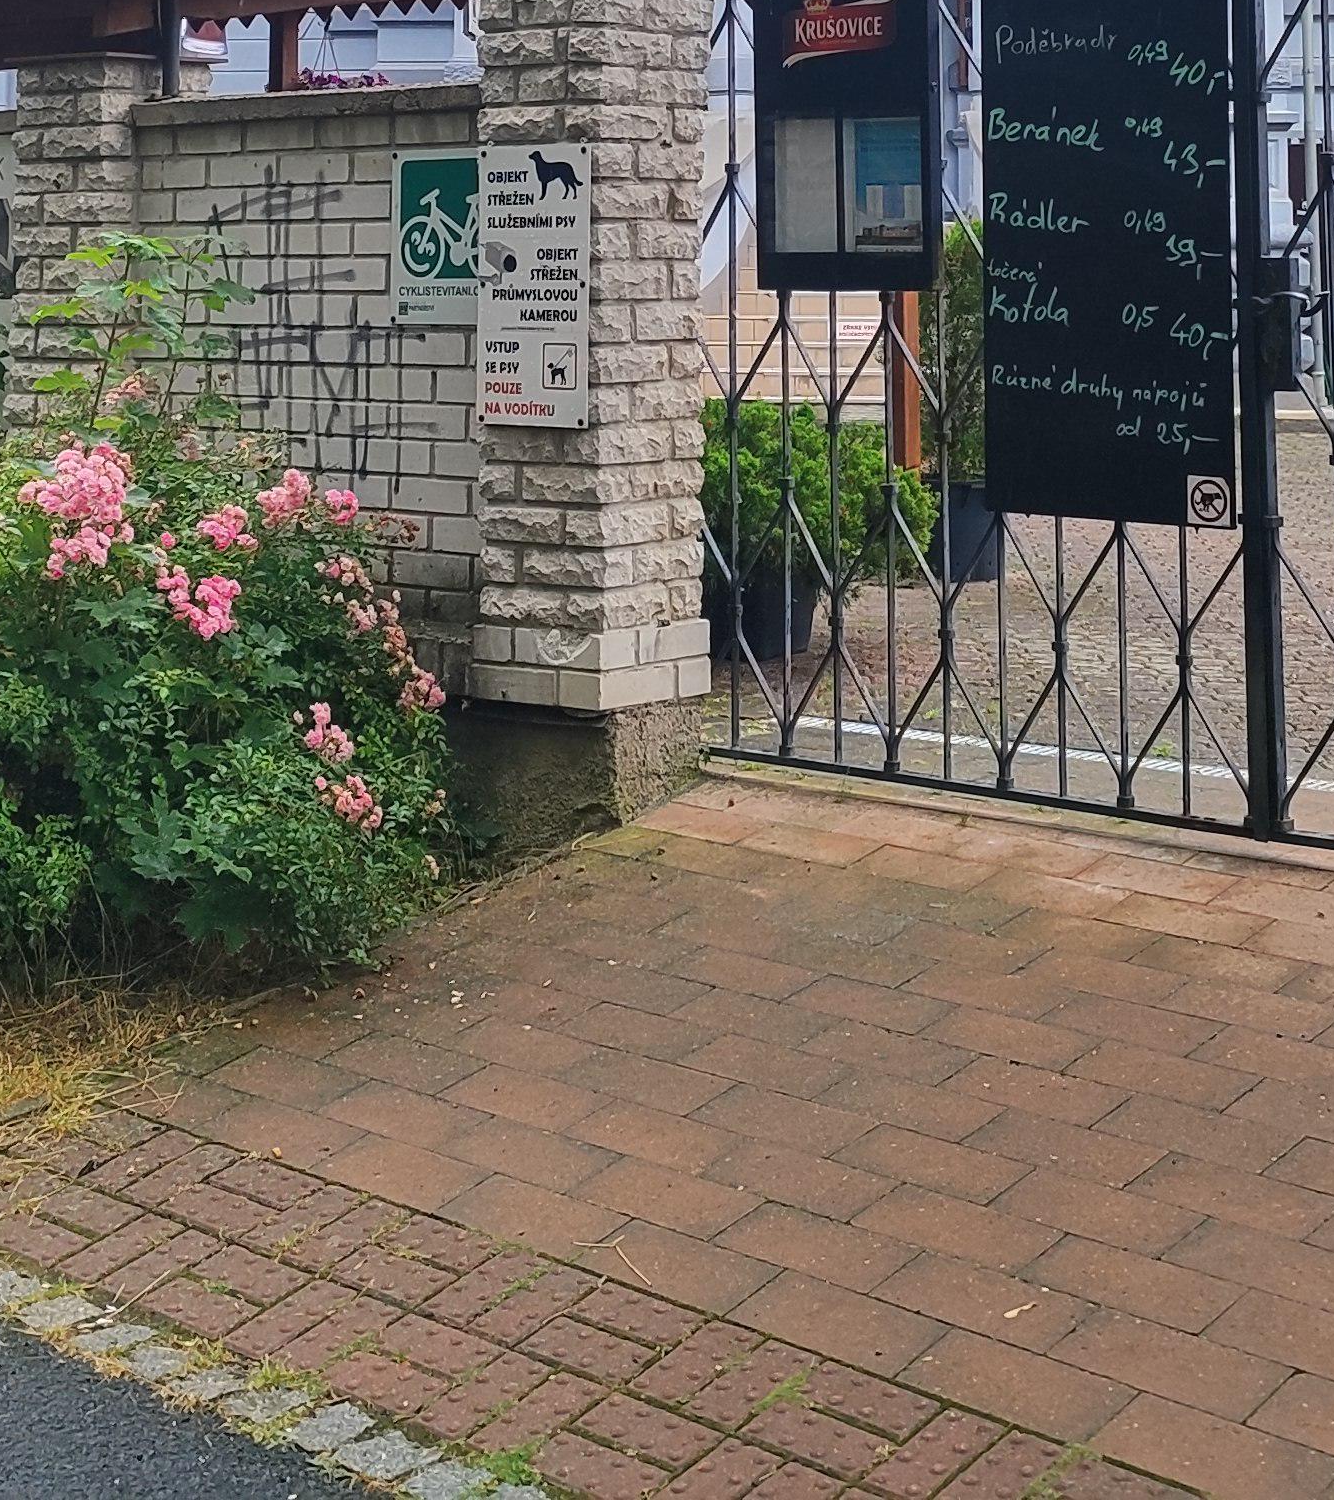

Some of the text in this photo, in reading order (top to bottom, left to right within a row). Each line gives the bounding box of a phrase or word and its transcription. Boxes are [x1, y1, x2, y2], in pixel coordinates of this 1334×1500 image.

[795, 15, 883, 46] KRUŠOVICE
[987, 105, 1105, 152] Beránek
[487, 170, 529, 184] OBJEKT
[487, 191, 534, 207] STŘEŽEN
[988, 191, 1090, 234] Rádler
[487, 213, 576, 230] SLUŽEBNÍMI PSY
[536, 248, 579, 262] OBJEKT
[530, 264, 578, 281] STŘEŽEN
[492, 284, 578, 302] PRŮMYSLOVOU
[519, 309, 578, 322] KAMEROU
[1121, 303, 1160, 333] 0,5
[485, 341, 520, 354] VSTUP
[485, 361, 520, 374] SE PSY
[484, 381, 523, 395] POUZE
[484, 399, 555, 417] NA VODÍTKU
[1117, 415, 1142, 437] od
